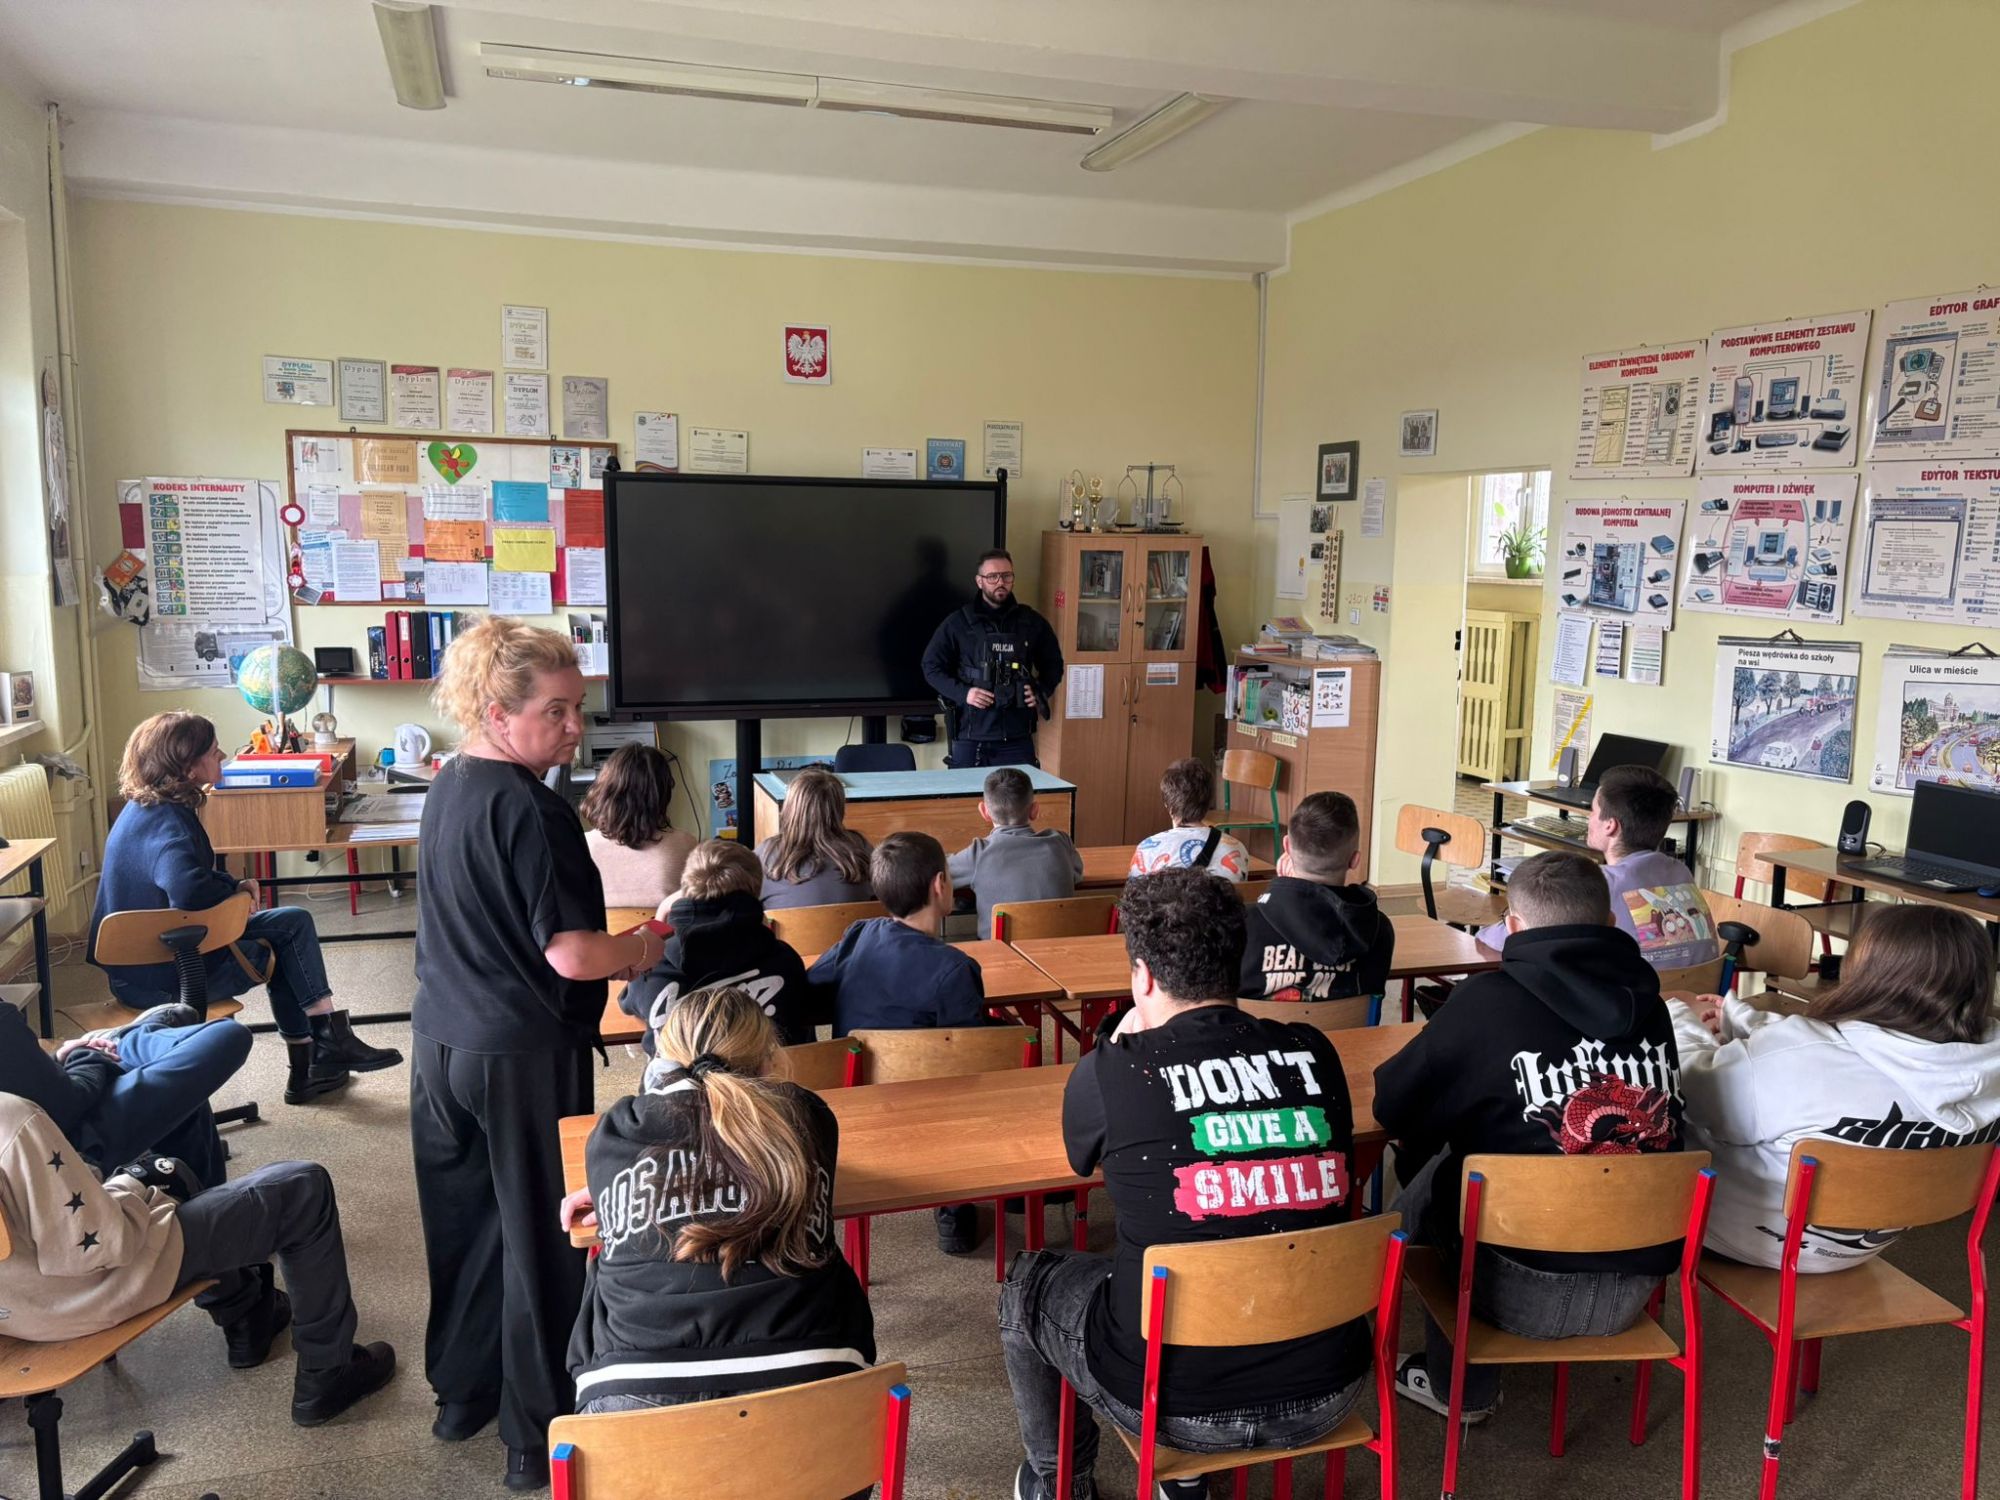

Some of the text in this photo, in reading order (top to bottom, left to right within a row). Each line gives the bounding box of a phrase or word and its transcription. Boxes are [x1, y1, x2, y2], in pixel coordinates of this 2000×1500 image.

[1929, 301, 1968, 316] EDYTOR
[1721, 322, 1856, 349] PODSTAWOWE ELEMENTY ZESTAWU
[1750, 340, 1821, 357] KOMPUTEROWEGO
[1589, 349, 1695, 371] ELEMENTY ZEWNĘTRZNE OBUDOWY
[344, 365, 379, 374] Dyplom
[1621, 365, 1658, 378] KOMPUTERA
[398, 375, 432, 384] Dyplom
[454, 378, 488, 387] Dyplom
[513, 386, 539, 394] DYPLOM
[1921, 470, 1958, 481] EDYTOR
[153, 483, 245, 492] KODEKS INTERNAUTY
[1733, 482, 1815, 496] KOMPUTER I DŹWIĘK
[1575, 507, 1671, 518] BUDOWA JEDNOSTKI CENTRALNEJ
[1603, 518, 1638, 527] KOMPUTERA
[992, 643, 1015, 653] POLICJA
[1738, 648, 1835, 664] Piesza wędrówka do szkoły
[1909, 664, 1932, 674] Ulica
[1944, 665, 1979, 675] mieście
[1160, 1050, 1322, 1112] DON'T
[1204, 1110, 1319, 1147] GIVE A
[1194, 1159, 1340, 1209] SMILE
